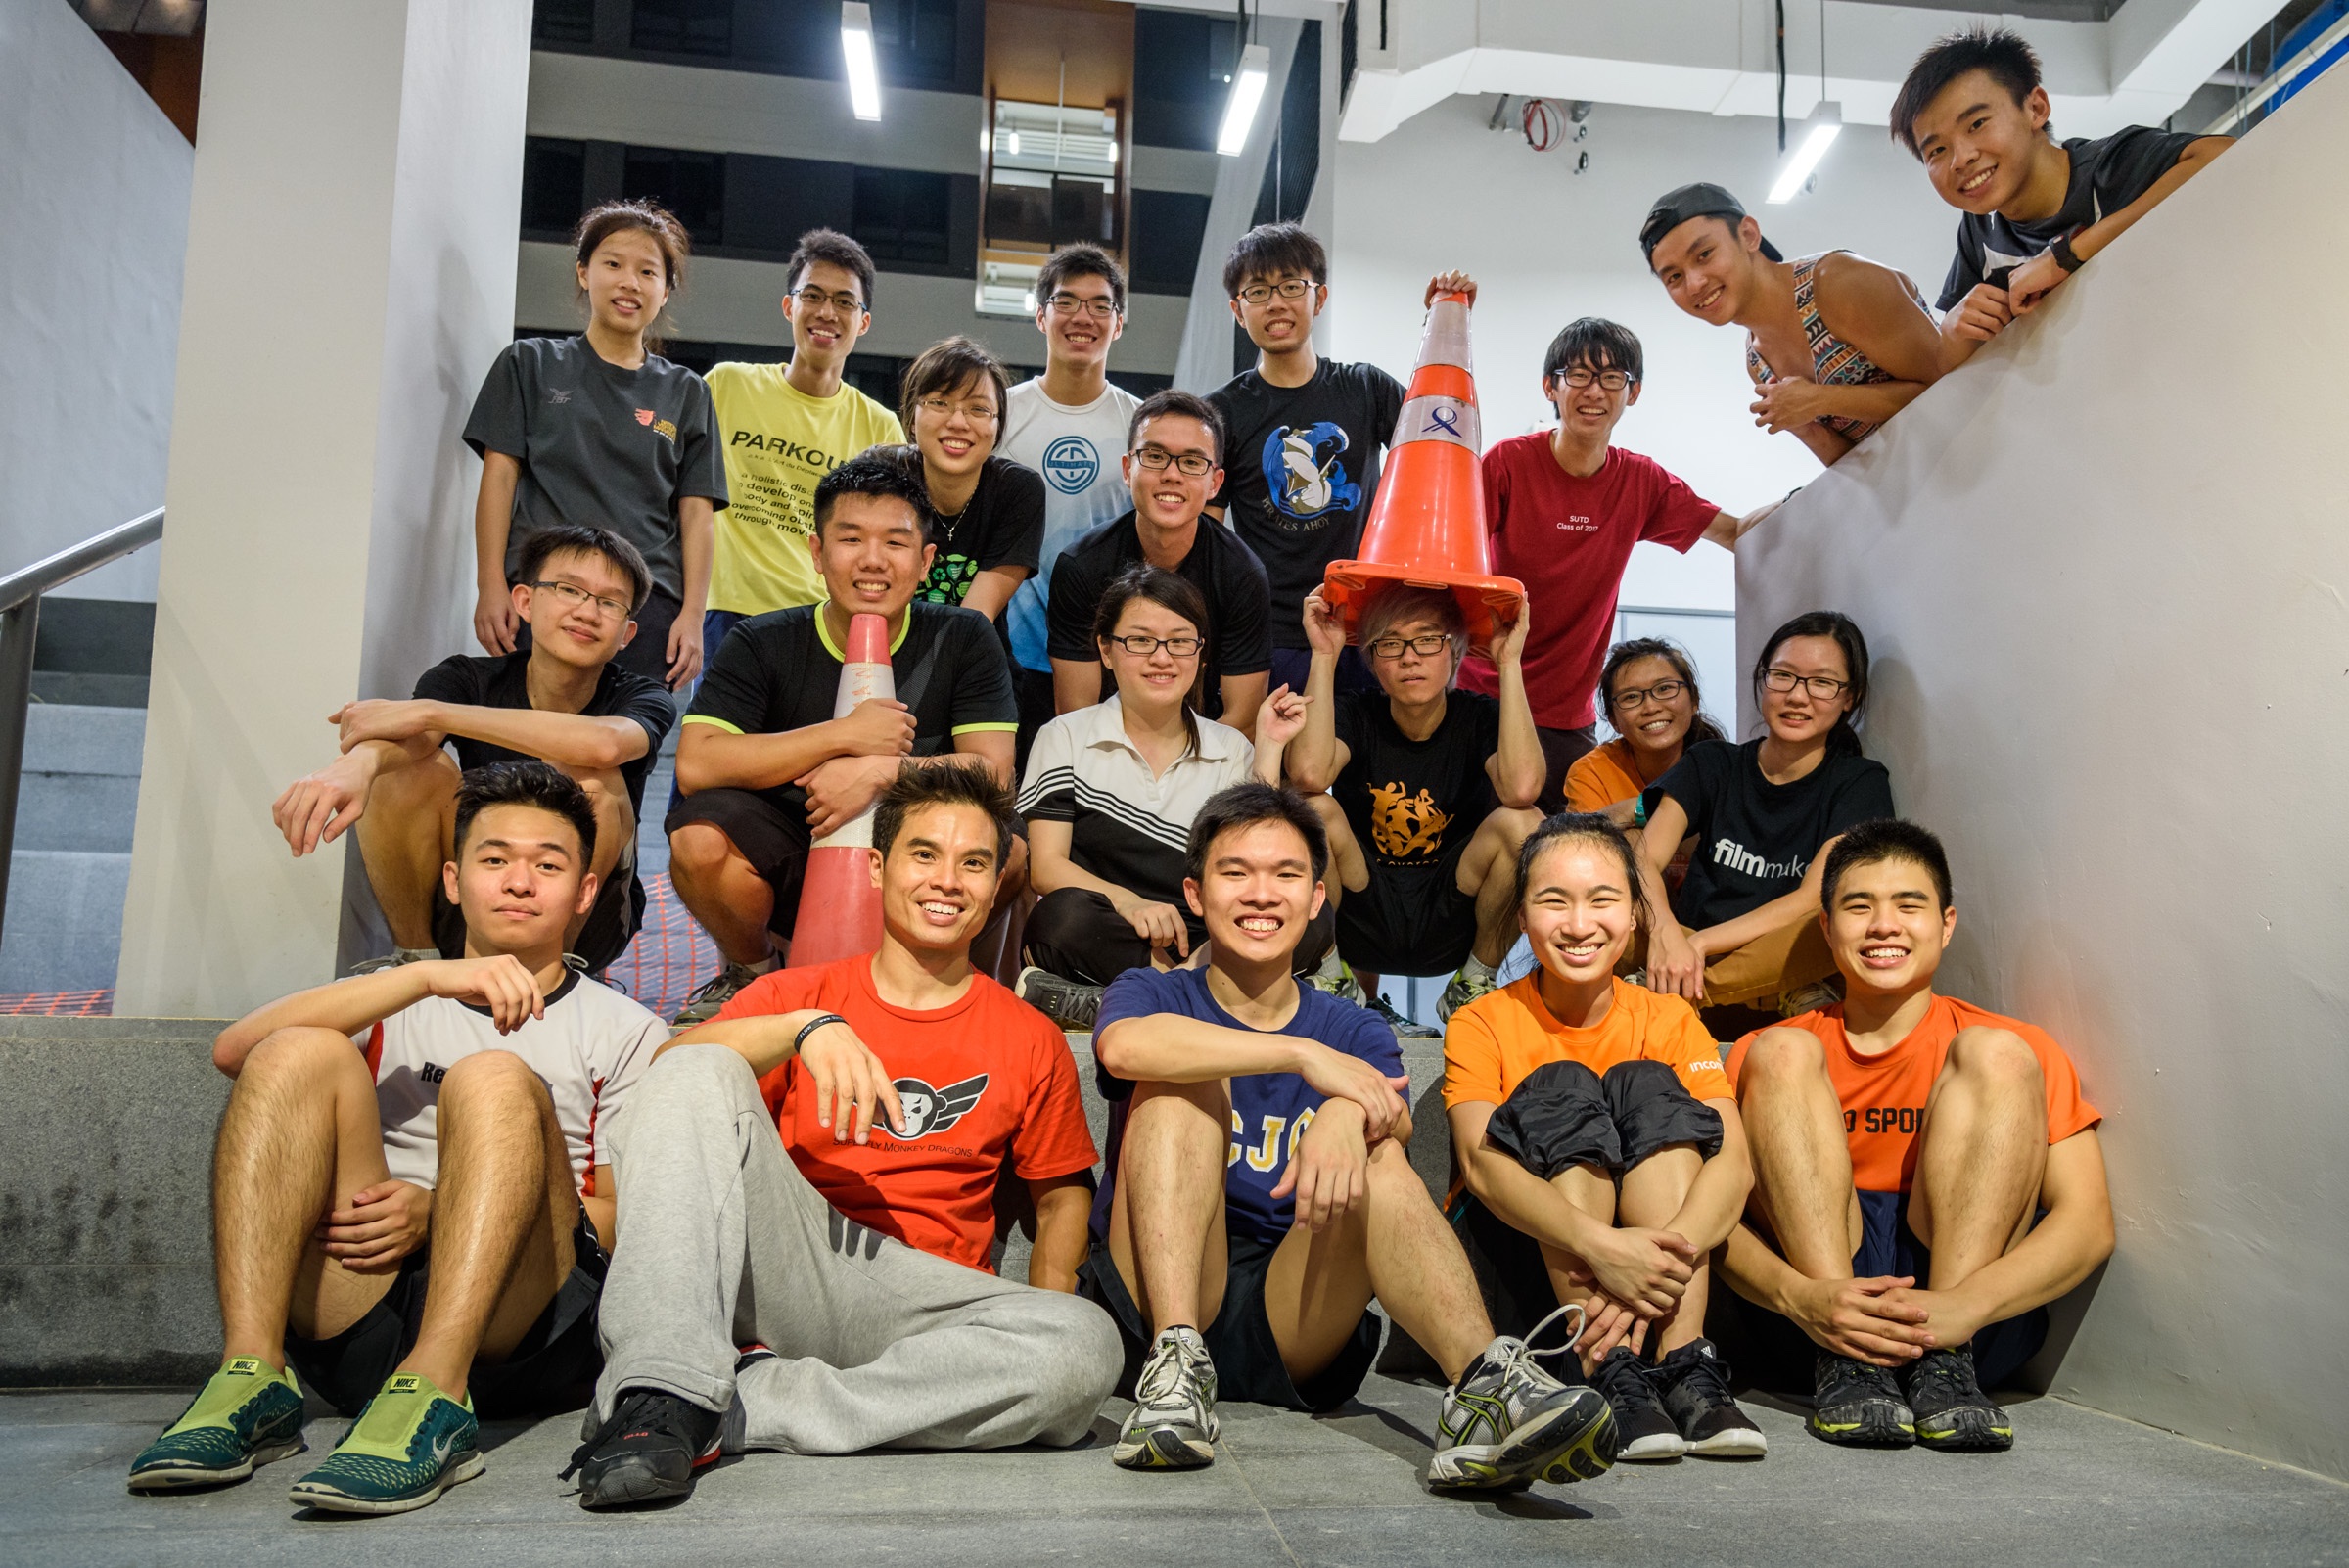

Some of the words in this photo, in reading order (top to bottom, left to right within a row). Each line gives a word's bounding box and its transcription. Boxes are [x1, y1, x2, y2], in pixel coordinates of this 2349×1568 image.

[751, 474, 788, 487] holistic
[747, 482, 796, 501] develop
[770, 500, 790, 510] and
[731, 503, 786, 522] overcoming
[1303, 516, 1330, 531] AHOY
[1569, 515, 1589, 524] SUTD
[884, 1142, 926, 1152] MONKEY
[928, 1144, 973, 1158] DRAGONS
[232, 1360, 256, 1370] NIKE
[393, 1378, 417, 1388] NIKE
